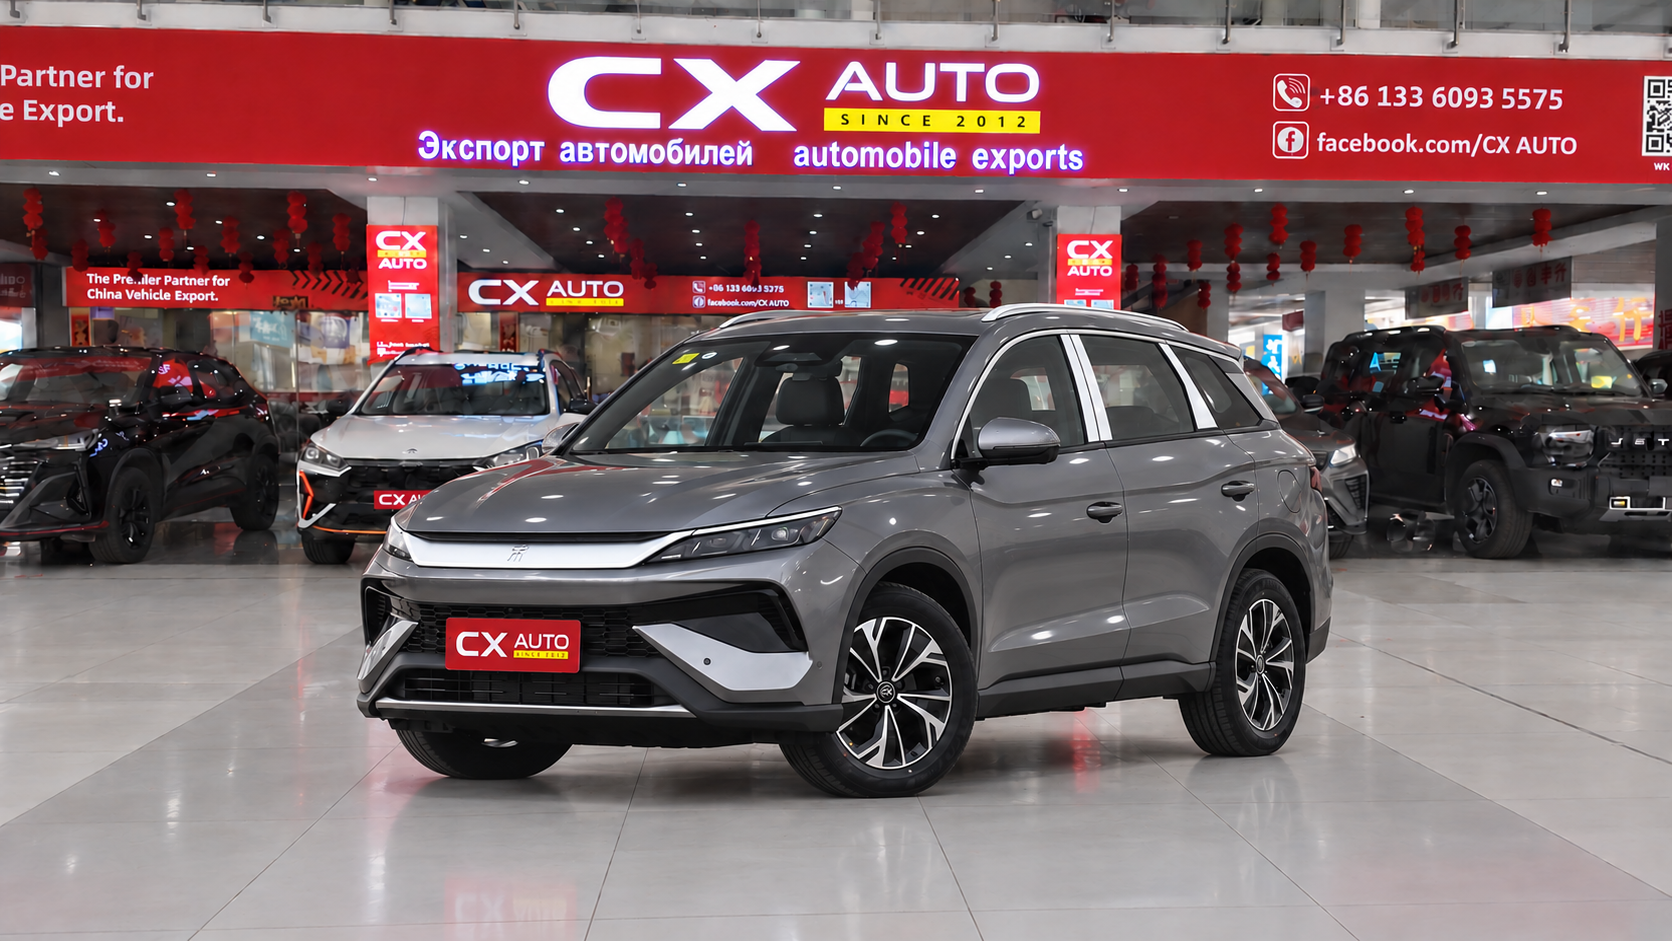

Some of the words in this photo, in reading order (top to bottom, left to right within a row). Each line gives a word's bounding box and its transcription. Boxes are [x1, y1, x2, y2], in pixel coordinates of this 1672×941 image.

[1, 64, 105, 88] Partner
[113, 65, 154, 89] for
[825, 61, 1040, 103] AUTO
[547, 56, 801, 132] CX
[1320, 86, 1369, 107] +86
[1377, 86, 1423, 108] 133
[1432, 87, 1494, 109] 6093
[1501, 88, 1563, 110] 5575
[23, 99, 124, 127] Export.
[841, 113, 931, 128] SINCE
[956, 115, 1026, 129] 2012
[417, 130, 545, 166] Экспорт
[559, 137, 753, 166] автомобилей
[1317, 132, 1510, 157] facebook.com/CX
[1516, 137, 1578, 155] AUTO
[793, 141, 957, 169] automobile
[971, 144, 1084, 174] exports
[376, 231, 427, 250] CX
[1067, 240, 1113, 259] CX
[378, 258, 427, 270] AUTO
[1067, 266, 1113, 277] AUTO
[86, 273, 109, 285] The
[164, 275, 210, 287] Partner
[212, 275, 231, 287] for
[546, 280, 624, 298] AUTO
[86, 288, 122, 300] China
[125, 288, 171, 301] Vehicle
[175, 290, 219, 304] Export.
[468, 279, 540, 306] CX
[378, 494, 406, 506] CX
[455, 631, 508, 657] CX
[513, 633, 569, 650] AUTO
